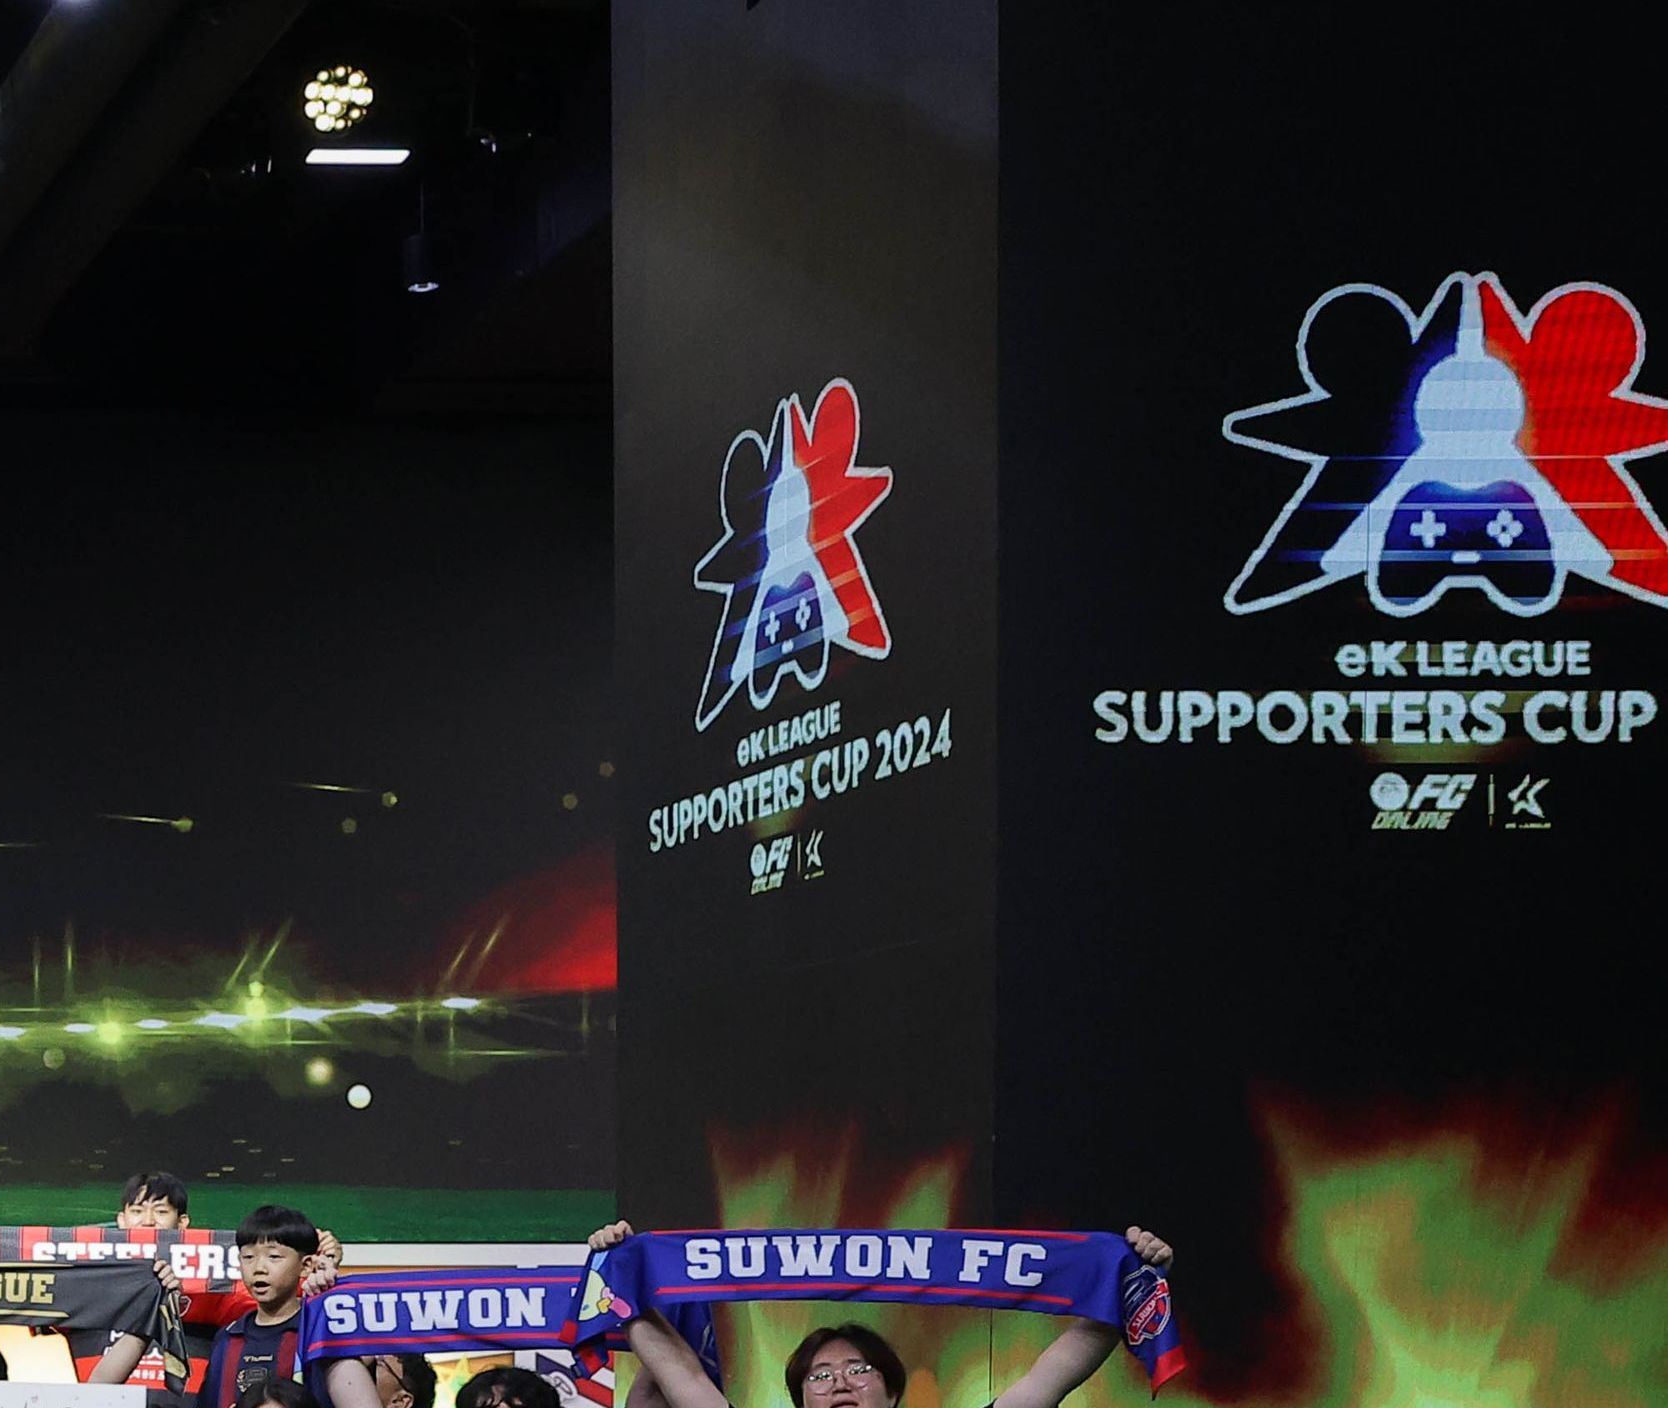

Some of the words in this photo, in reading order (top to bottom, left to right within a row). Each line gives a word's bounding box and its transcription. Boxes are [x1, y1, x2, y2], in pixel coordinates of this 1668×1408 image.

[1334, 641, 1408, 678] eK
[1416, 640, 1592, 677] LEAGUE
[768, 699, 842, 757] LEAGUE
[1092, 690, 1508, 744] SUPPORTERS
[1522, 690, 1659, 744] CUP
[648, 757, 805, 853] SUPPORTERS
[810, 736, 870, 800] CUP
[874, 707, 953, 780] 2024
[684, 1234, 934, 1282] SUWON
[959, 1237, 1048, 1288] FC
[325, 1286, 548, 1335] SUWON
